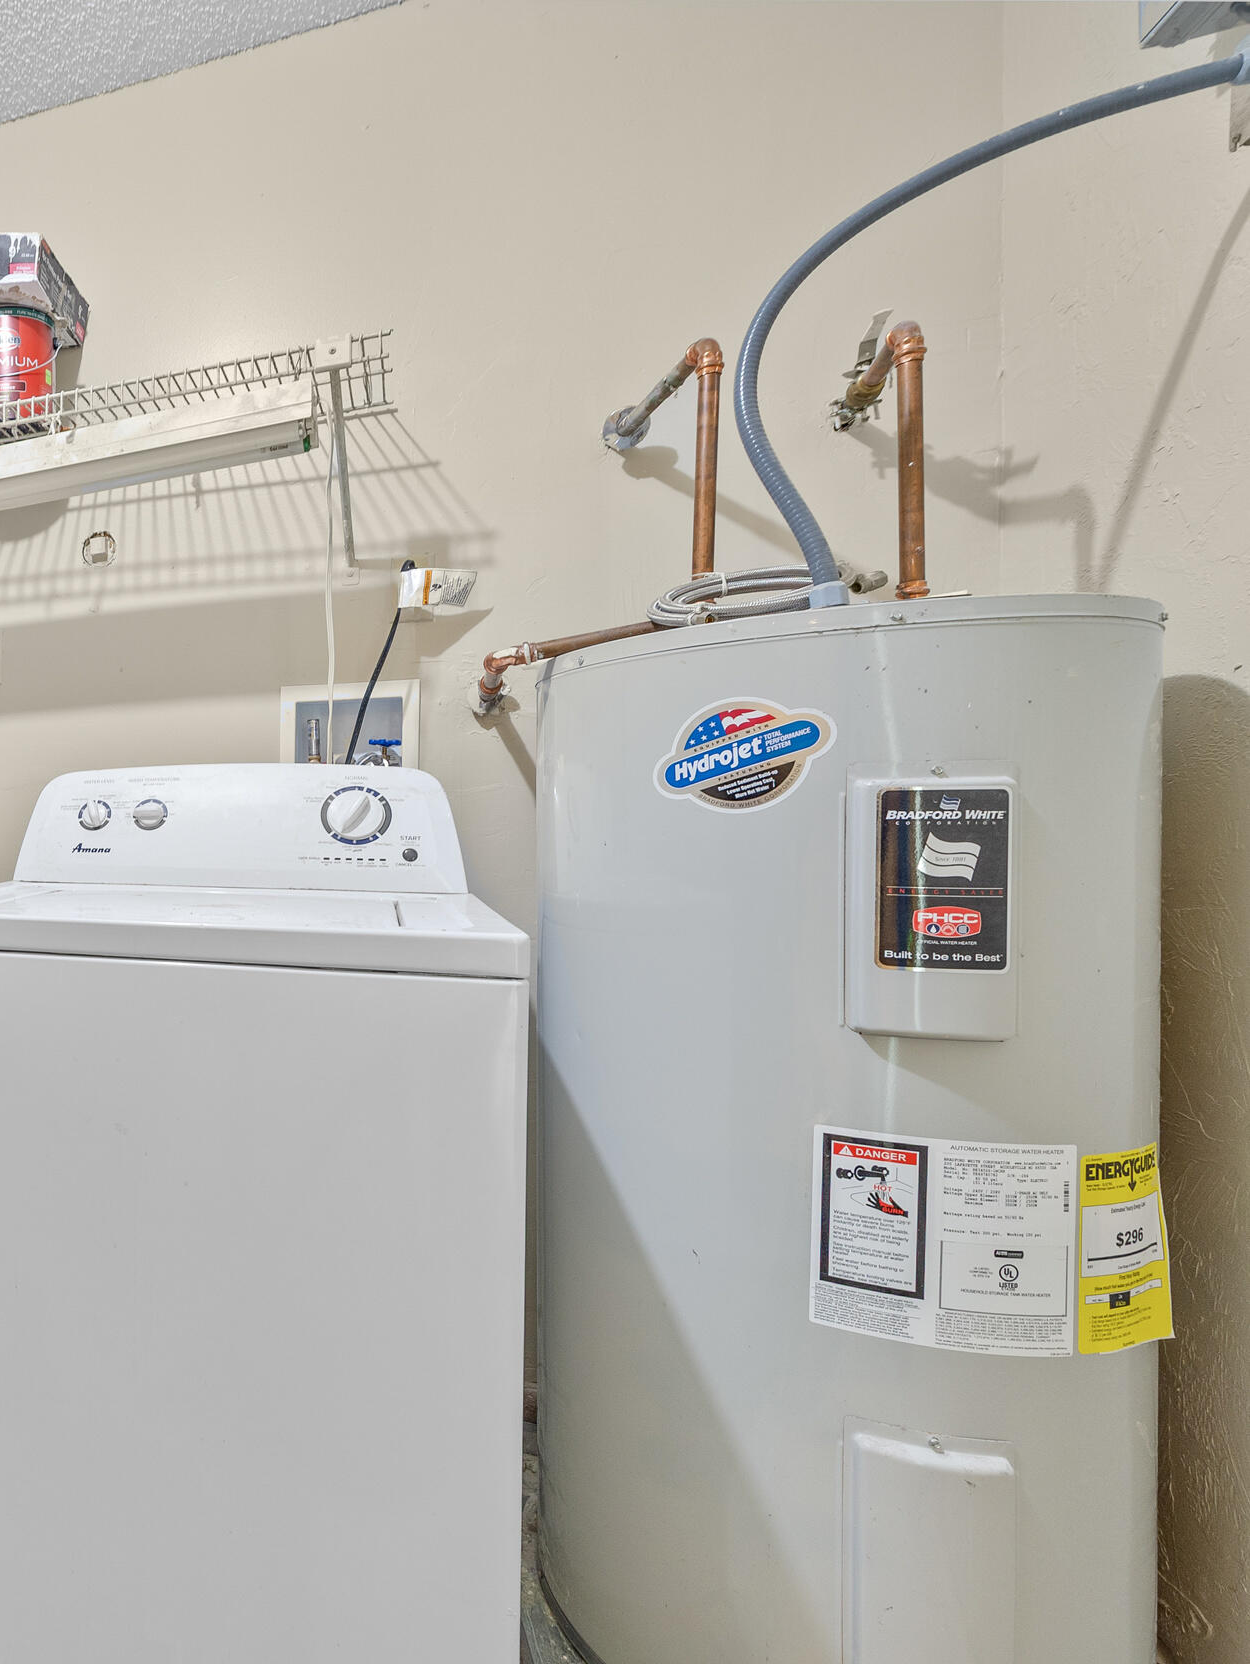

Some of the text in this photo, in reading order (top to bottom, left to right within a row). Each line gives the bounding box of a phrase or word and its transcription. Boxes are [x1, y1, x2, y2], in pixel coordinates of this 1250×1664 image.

[694, 723, 769, 752] EQUIPPED WITH
[763, 730, 782, 740] TOTAL
[765, 727, 811, 746] PERFORMANCE
[766, 740, 791, 753] SYSTEM
[675, 737, 763, 782] Hydrojet
[718, 762, 770, 781] FEATURING
[739, 799, 760, 808] WHITE
[886, 810, 1005, 820] BRADFORD WHITE
[72, 843, 111, 853] Amana
[917, 912, 978, 923] PHCC
[884, 950, 1000, 962] Built to be the Best
[855, 1148, 906, 1161] DANGER
[950, 1145, 989, 1153] AUTOMATIC
[874, 1184, 893, 1192] HOT
[850, 1213, 881, 1221] temperature
[1116, 1227, 1144, 1248] $296
[851, 1249, 883, 1258] temperature
[833, 1267, 865, 1278] Temperature
[1003, 1268, 1014, 1278] UL
